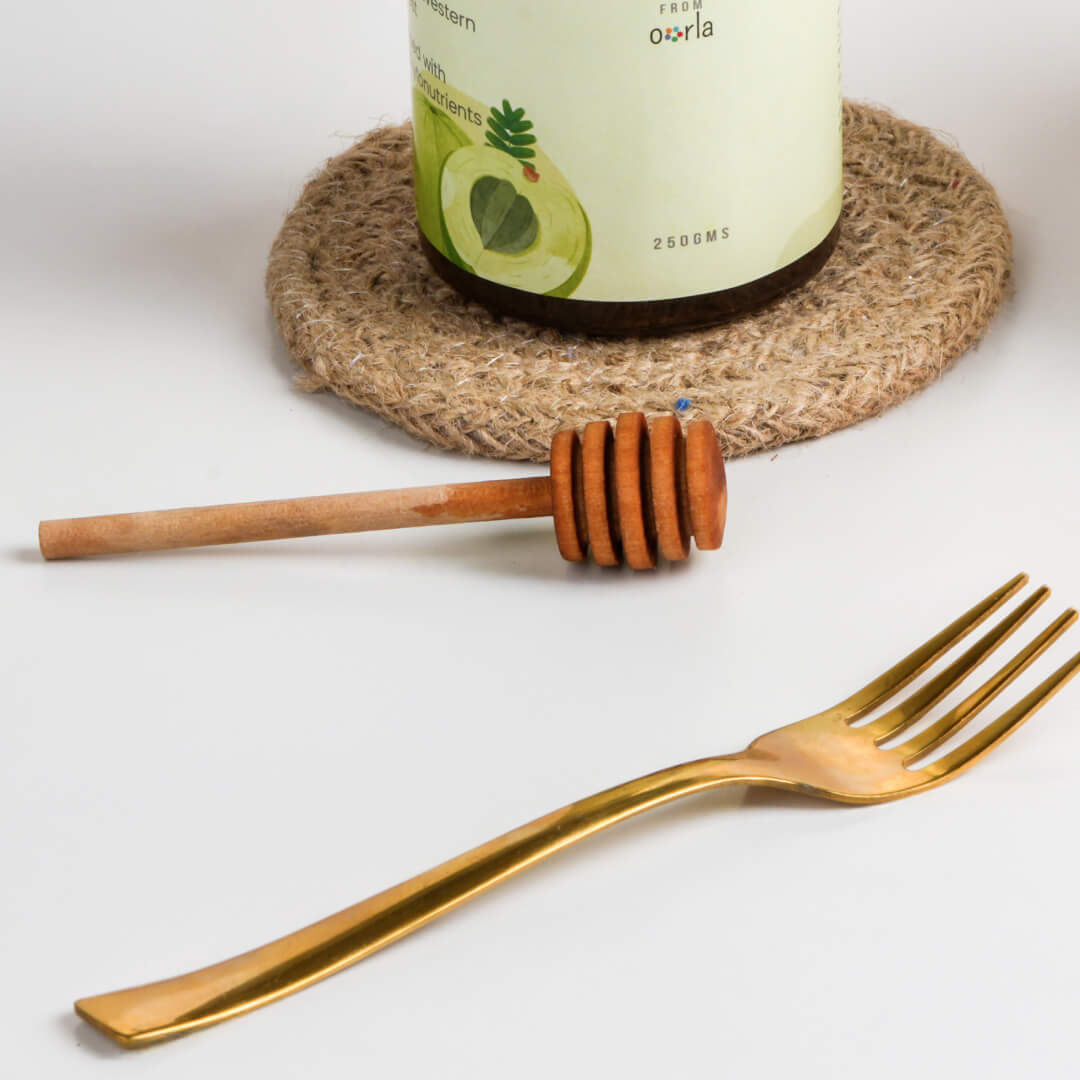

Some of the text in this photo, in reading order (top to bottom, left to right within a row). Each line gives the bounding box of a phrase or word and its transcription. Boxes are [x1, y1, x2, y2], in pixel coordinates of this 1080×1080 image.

[659, 0, 703, 15] FROM
[423, 54, 447, 84] with
[653, 227, 730, 251] 250GMS
